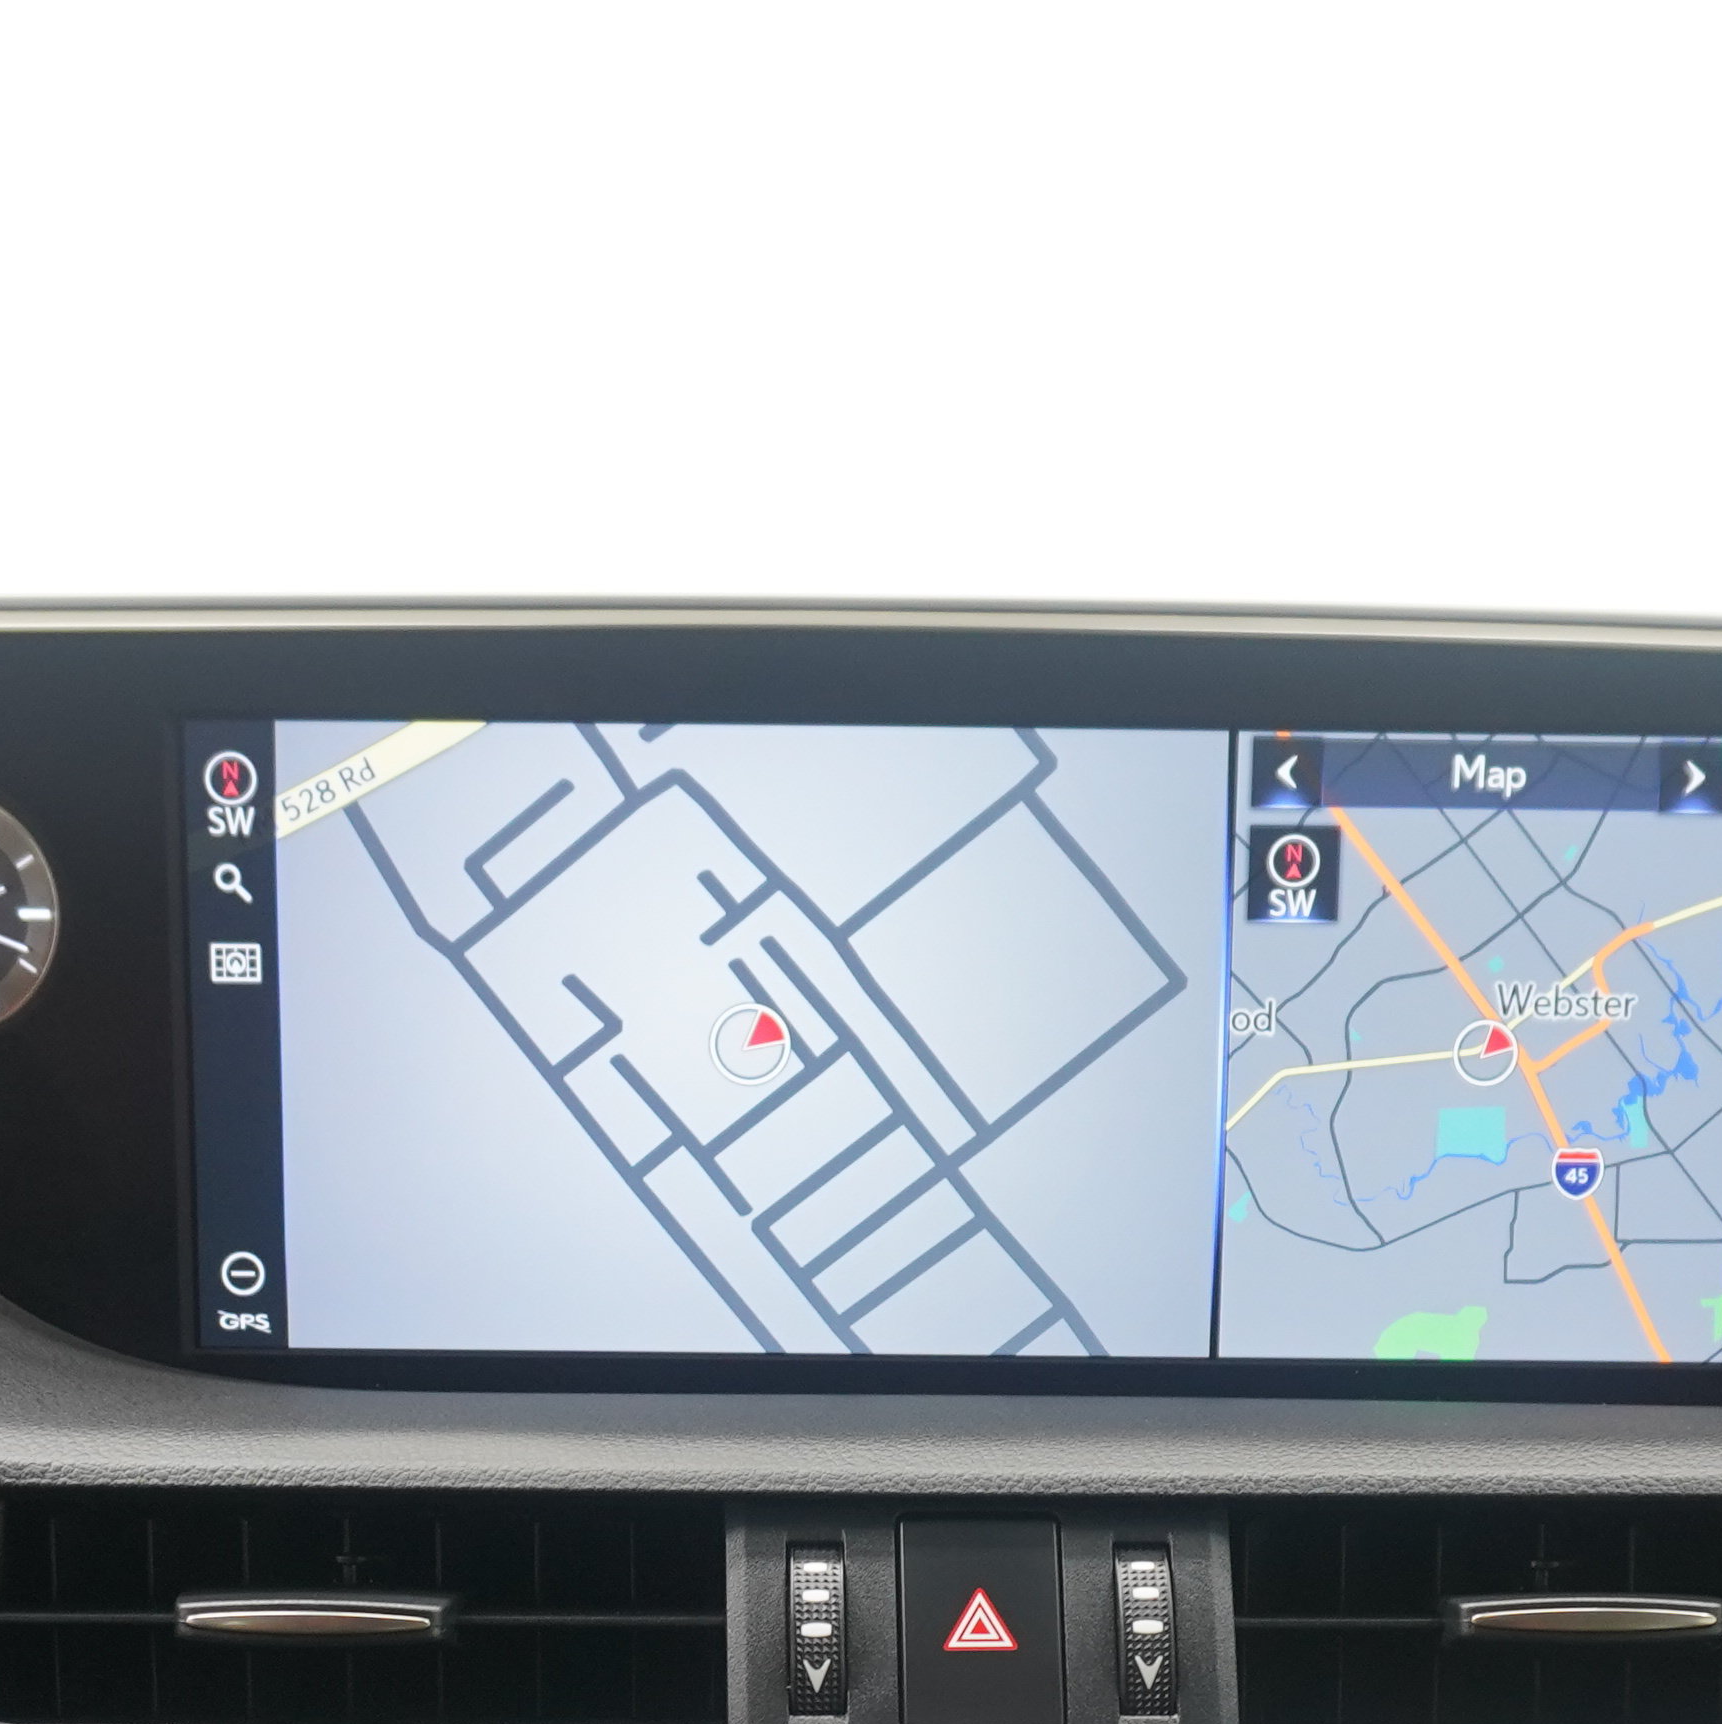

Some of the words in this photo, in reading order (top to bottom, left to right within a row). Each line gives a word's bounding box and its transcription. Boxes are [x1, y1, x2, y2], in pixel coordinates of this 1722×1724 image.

[221, 760, 239, 780] N
[1451, 755, 1527, 798] Map
[281, 780, 336, 821] 528
[338, 757, 376, 792] Rd
[208, 806, 255, 835] SW
[1286, 844, 1302, 861] N
[1269, 889, 1316, 918] SW
[1496, 983, 1636, 1018] Webster
[1231, 1002, 1273, 1032] od
[1565, 1168, 1588, 1184] 45
[218, 1310, 271, 1333] GPS
